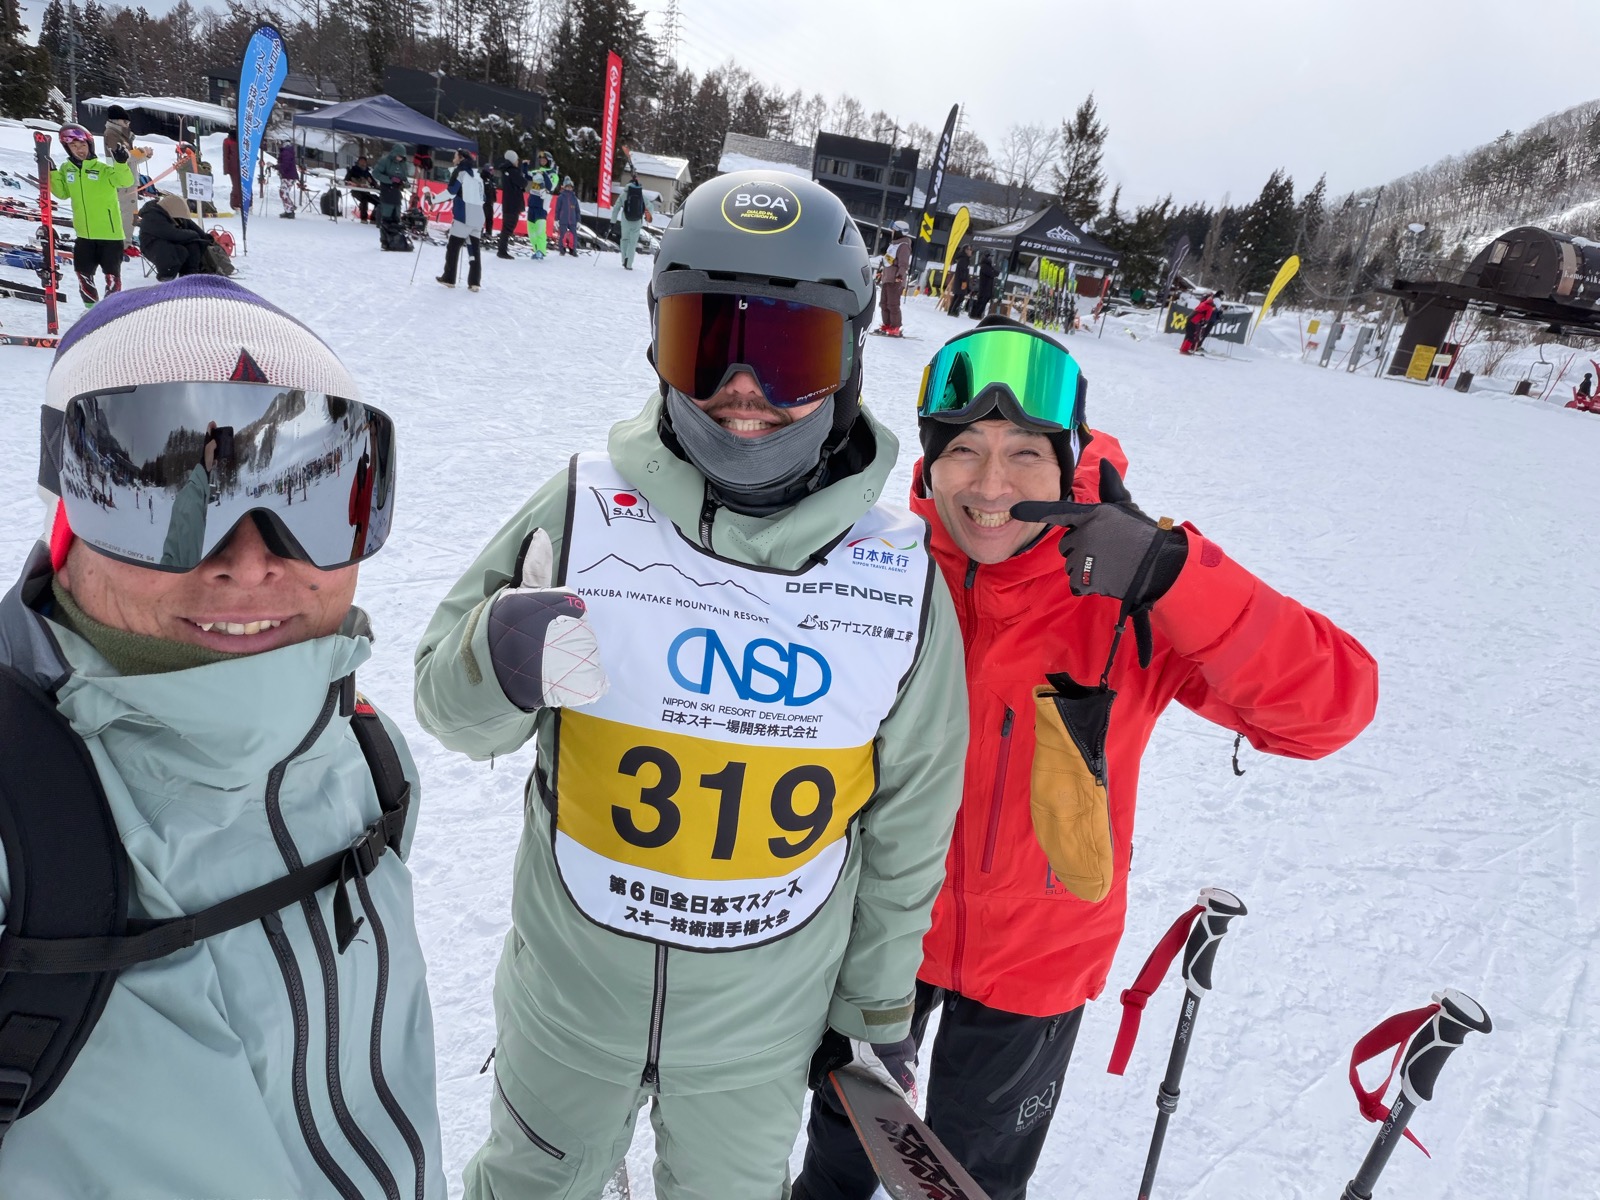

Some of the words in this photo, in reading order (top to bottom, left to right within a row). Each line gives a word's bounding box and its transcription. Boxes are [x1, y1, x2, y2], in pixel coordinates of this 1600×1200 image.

[852, 547, 909, 568] 日本旅行
[852, 560, 869, 568] NIPPON
[870, 563, 887, 571] TRAVEL
[888, 566, 907, 574] AGENCY
[577, 588, 623, 598] HAKUBA
[626, 591, 672, 606] IWATAKE
[675, 598, 730, 617] MOUNTAIN
[734, 611, 770, 625] RESORT
[785, 581, 914, 608] DEFENDER
[662, 696, 698, 710] NIPPON
[700, 703, 715, 713] SKI
[718, 705, 757, 718] RESORT
[759, 711, 823, 723] DEVELOPMENT
[661, 709, 819, 739] 日本スキー場開発株式会社
[611, 745, 837, 860] 319
[624, 906, 791, 938] スキー技術選手権大会
